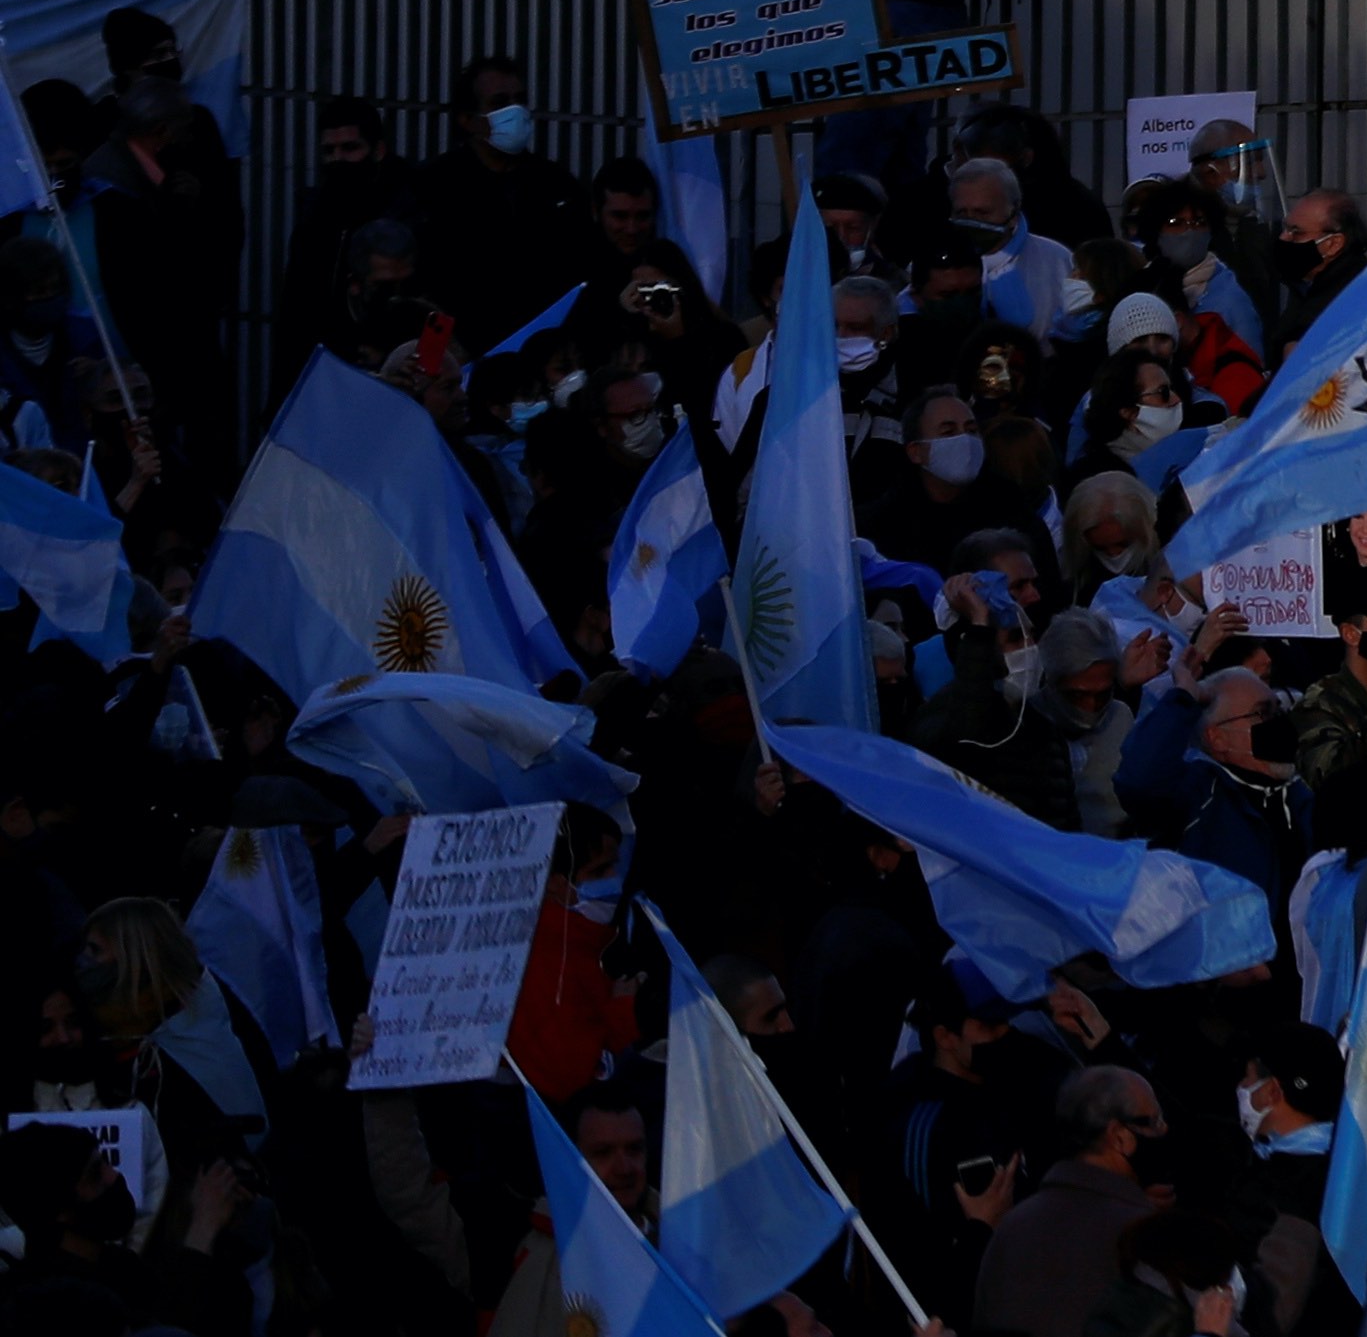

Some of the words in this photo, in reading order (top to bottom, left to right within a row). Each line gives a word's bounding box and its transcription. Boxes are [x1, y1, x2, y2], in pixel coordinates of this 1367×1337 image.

[685, 10, 738, 33] los
[690, 21, 845, 63] elegimos
[660, 63, 748, 100] VIVIR
[754, 39, 1008, 108] LIBERTAD
[679, 101, 721, 132] EN
[1141, 119, 1195, 133] Alberto
[1142, 142, 1167, 154] nos
